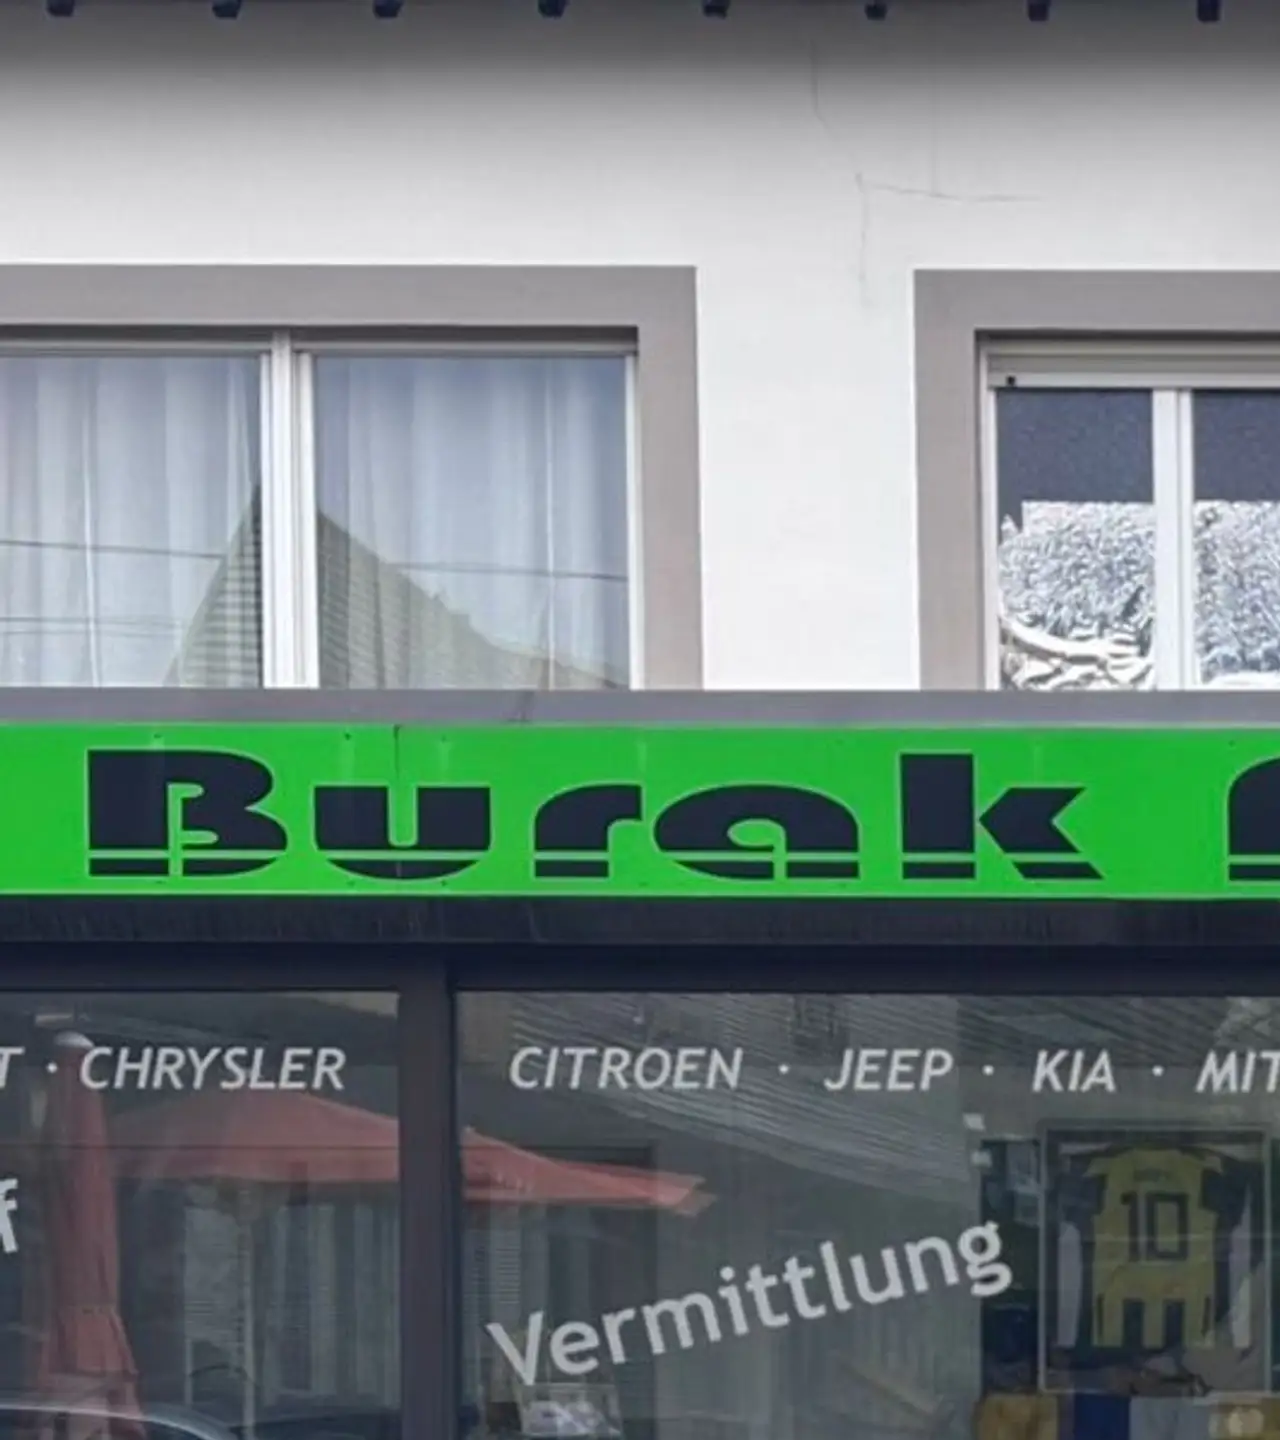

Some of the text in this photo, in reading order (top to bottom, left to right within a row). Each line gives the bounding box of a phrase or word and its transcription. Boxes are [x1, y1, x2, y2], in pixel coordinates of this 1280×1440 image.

[87, 748, 1105, 881] Burak
[79, 1045, 347, 1092] CHRYSLER
[508, 1045, 745, 1092] CITROEN
[823, 1047, 954, 1093] JEEP
[1031, 1049, 1116, 1093] KIA
[1120, 1191, 1190, 1262] 10
[486, 1219, 1013, 1387] Vermittlung
